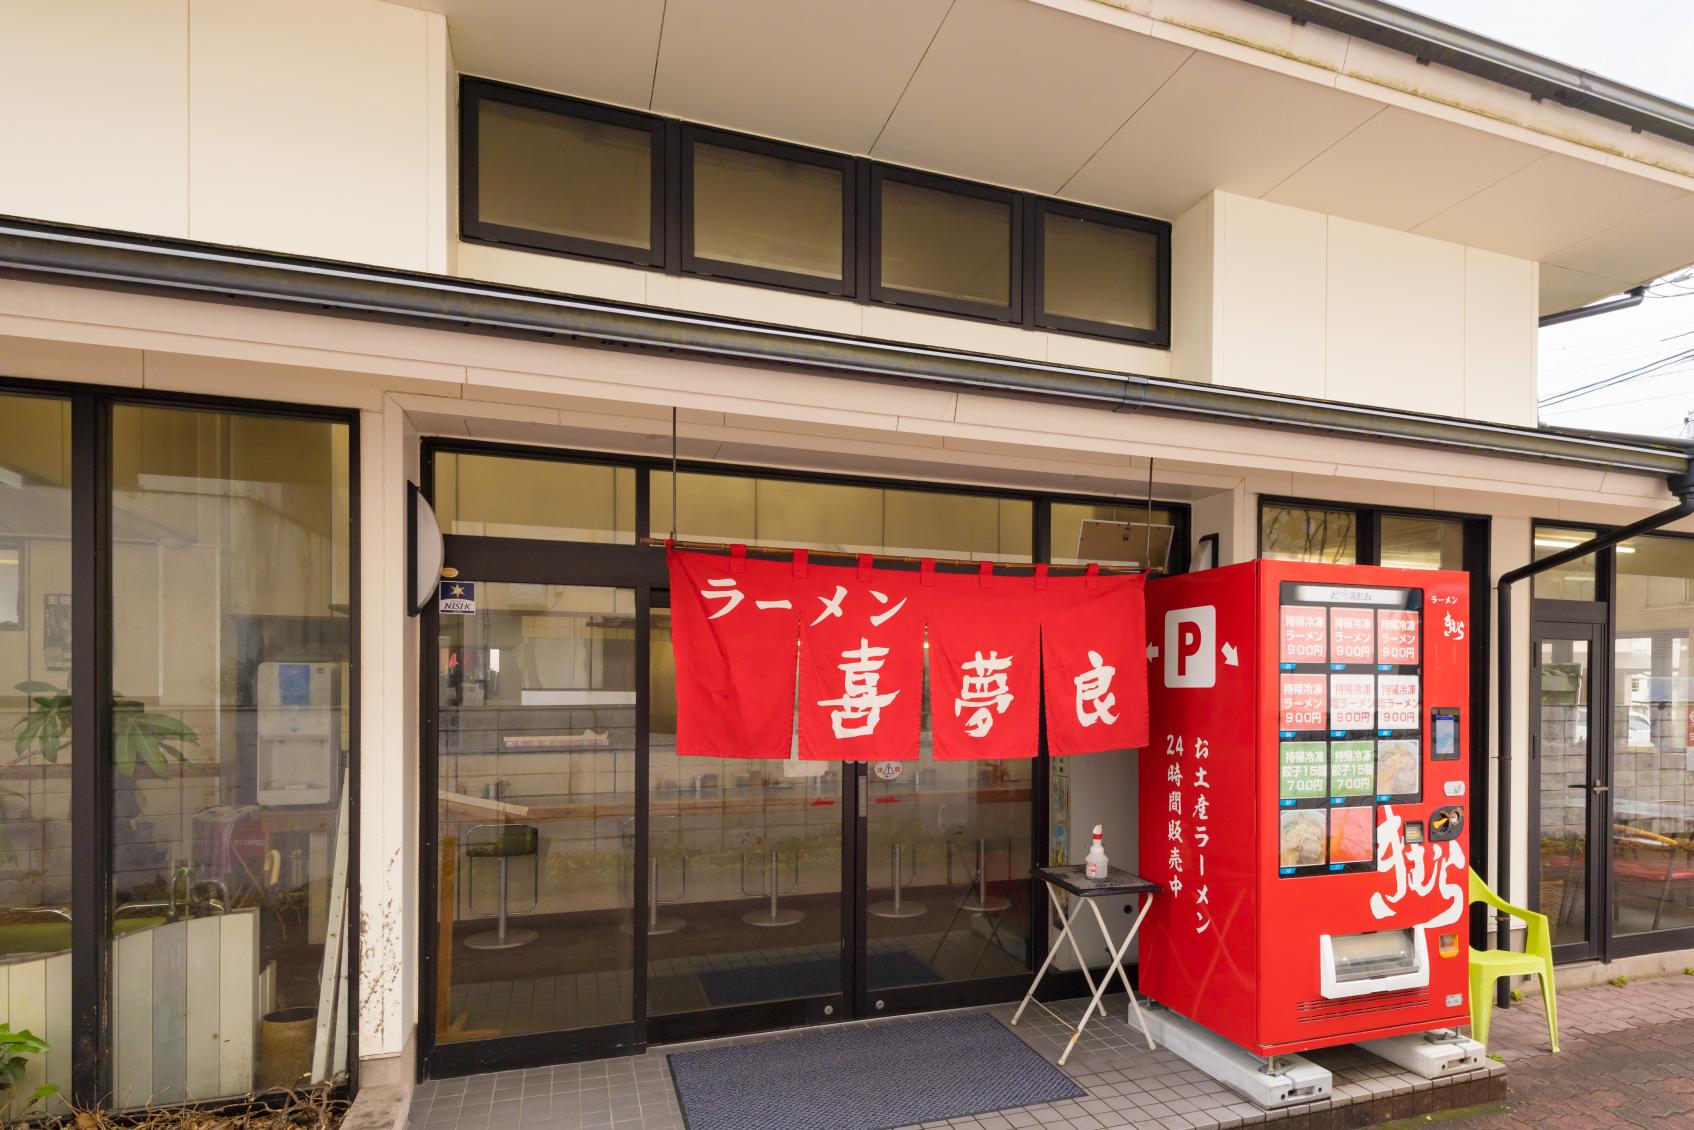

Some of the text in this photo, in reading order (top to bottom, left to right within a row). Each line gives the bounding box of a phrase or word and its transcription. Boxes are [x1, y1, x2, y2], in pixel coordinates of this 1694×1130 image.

[701, 578, 907, 627] ラーメン
[1430, 595, 1459, 604] ラーメン
[1286, 631, 1324, 642] ラーメン
[1335, 633, 1371, 644] ラーメン
[1381, 634, 1416, 645] ラーメン
[1178, 621, 1202, 676] P
[1287, 645, 1323, 657] 900円
[1336, 646, 1370, 658] 900円
[1382, 647, 1415, 659] 900円
[817, 637, 1121, 739] 喜夢良
[1284, 699, 1322, 709] ラーメン
[1285, 712, 1322, 724] 900円
[1337, 712, 1370, 723] 900円
[1383, 712, 1415, 723] 900円
[1287, 780, 1323, 791] 700円
[1337, 778, 1370, 790] 700円
[1166, 734, 1184, 899] 24時間販売中
[1192, 737, 1210, 934] お土産ラーメン
